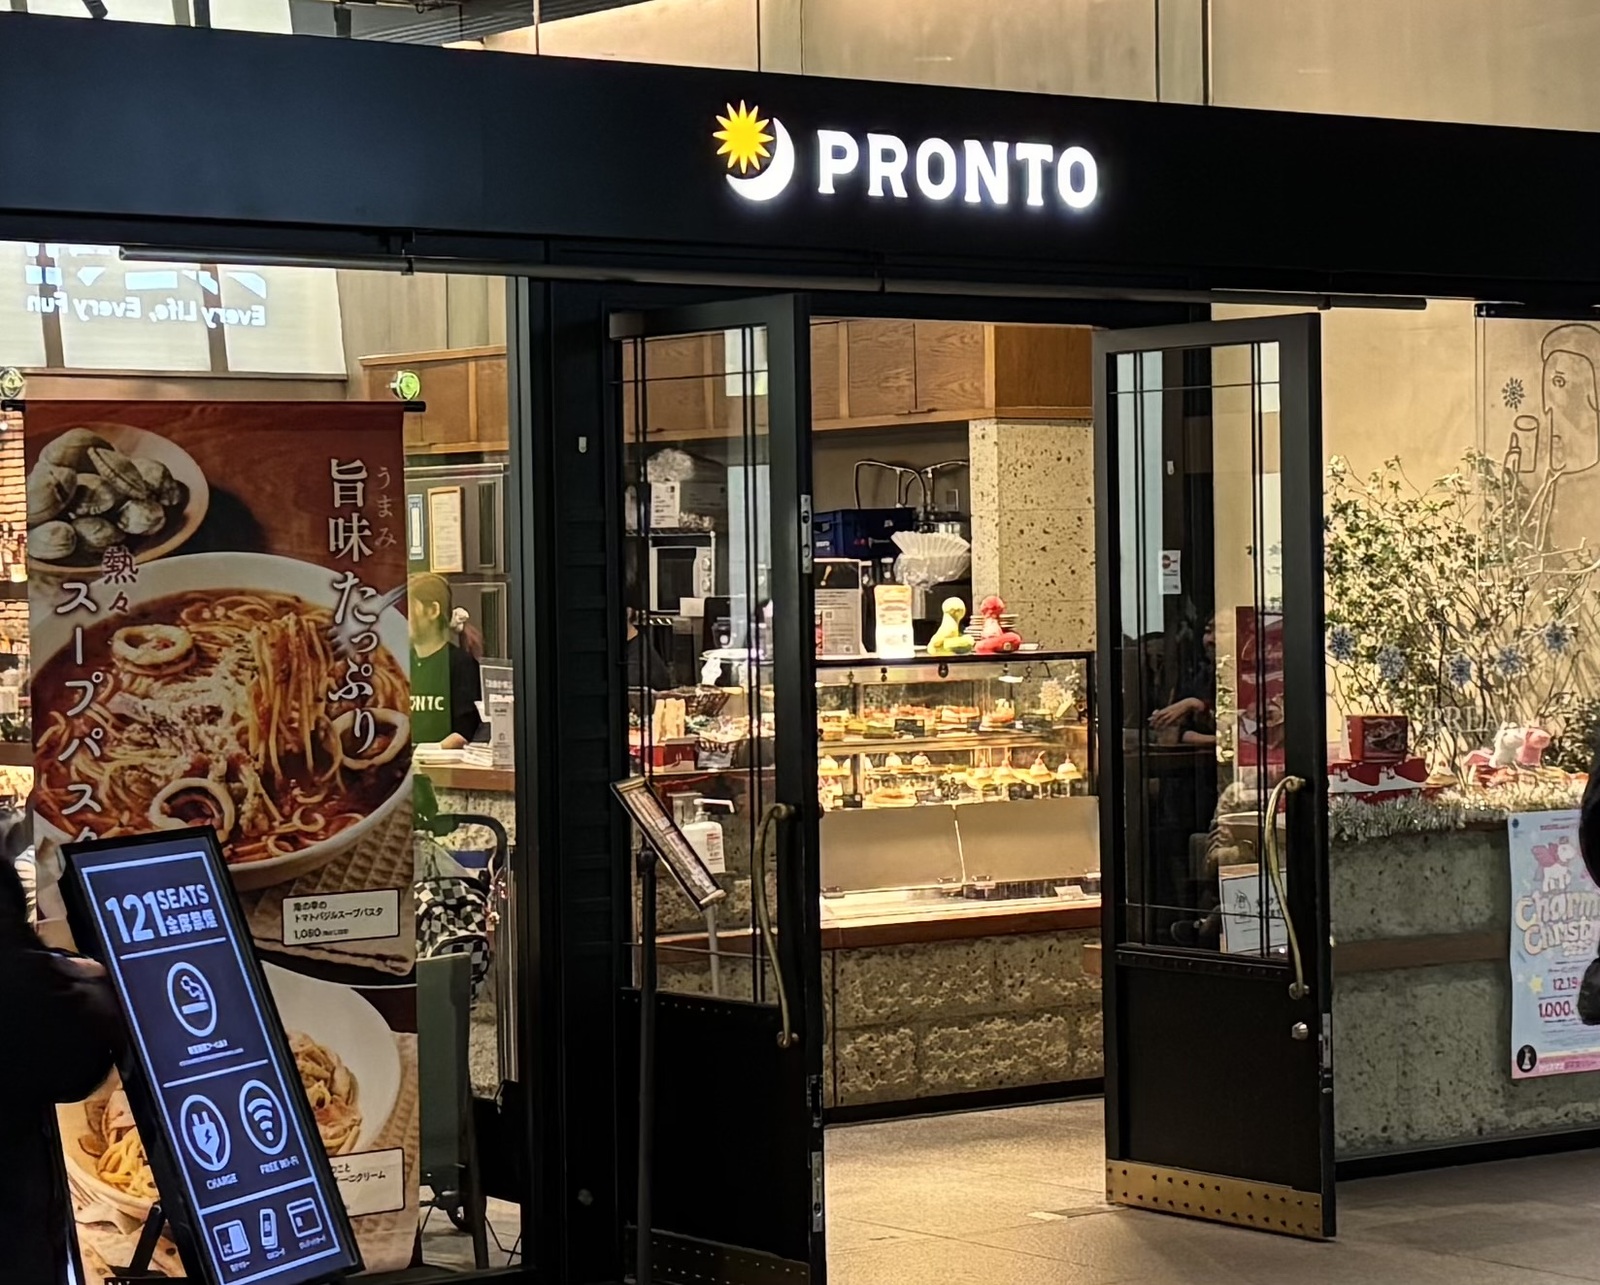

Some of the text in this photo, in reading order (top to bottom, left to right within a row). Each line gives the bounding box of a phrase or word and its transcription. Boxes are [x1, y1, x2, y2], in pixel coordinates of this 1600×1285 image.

[816, 129, 1099, 209] PRONTO
[374, 466, 398, 548] うまみ
[102, 546, 140, 615] 熱々
[328, 457, 381, 755] 旨味たっぷり
[104, 883, 210, 944] 121 SEATS
[336, 1170, 386, 1183] ーニクリーム
